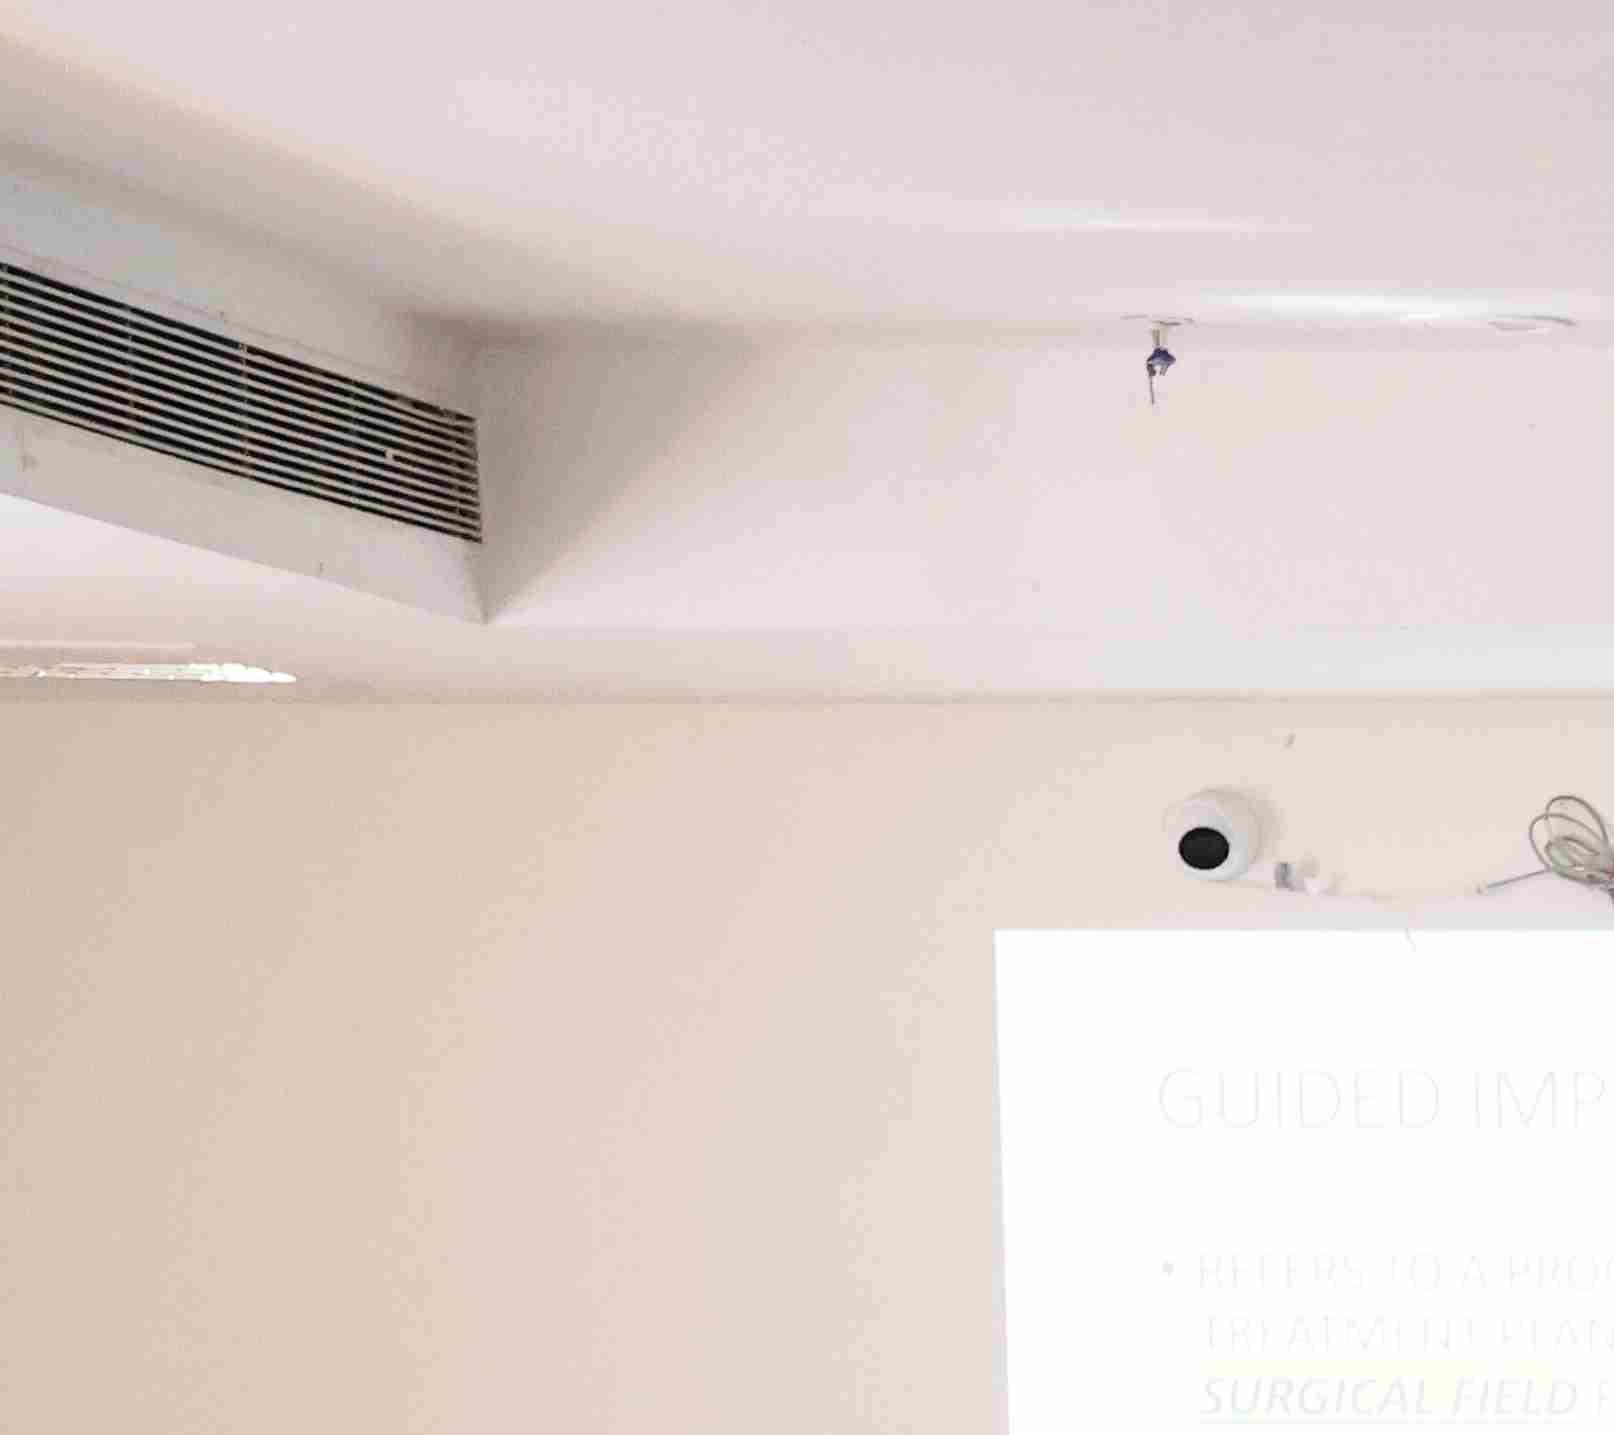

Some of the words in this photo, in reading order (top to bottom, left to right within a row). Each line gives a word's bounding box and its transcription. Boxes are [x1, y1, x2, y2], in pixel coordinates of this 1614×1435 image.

[1157, 1066, 1442, 1129] GUIDED
[1200, 1376, 1433, 1417] SURGICAL
[1451, 1376, 1578, 1417] FIELD
